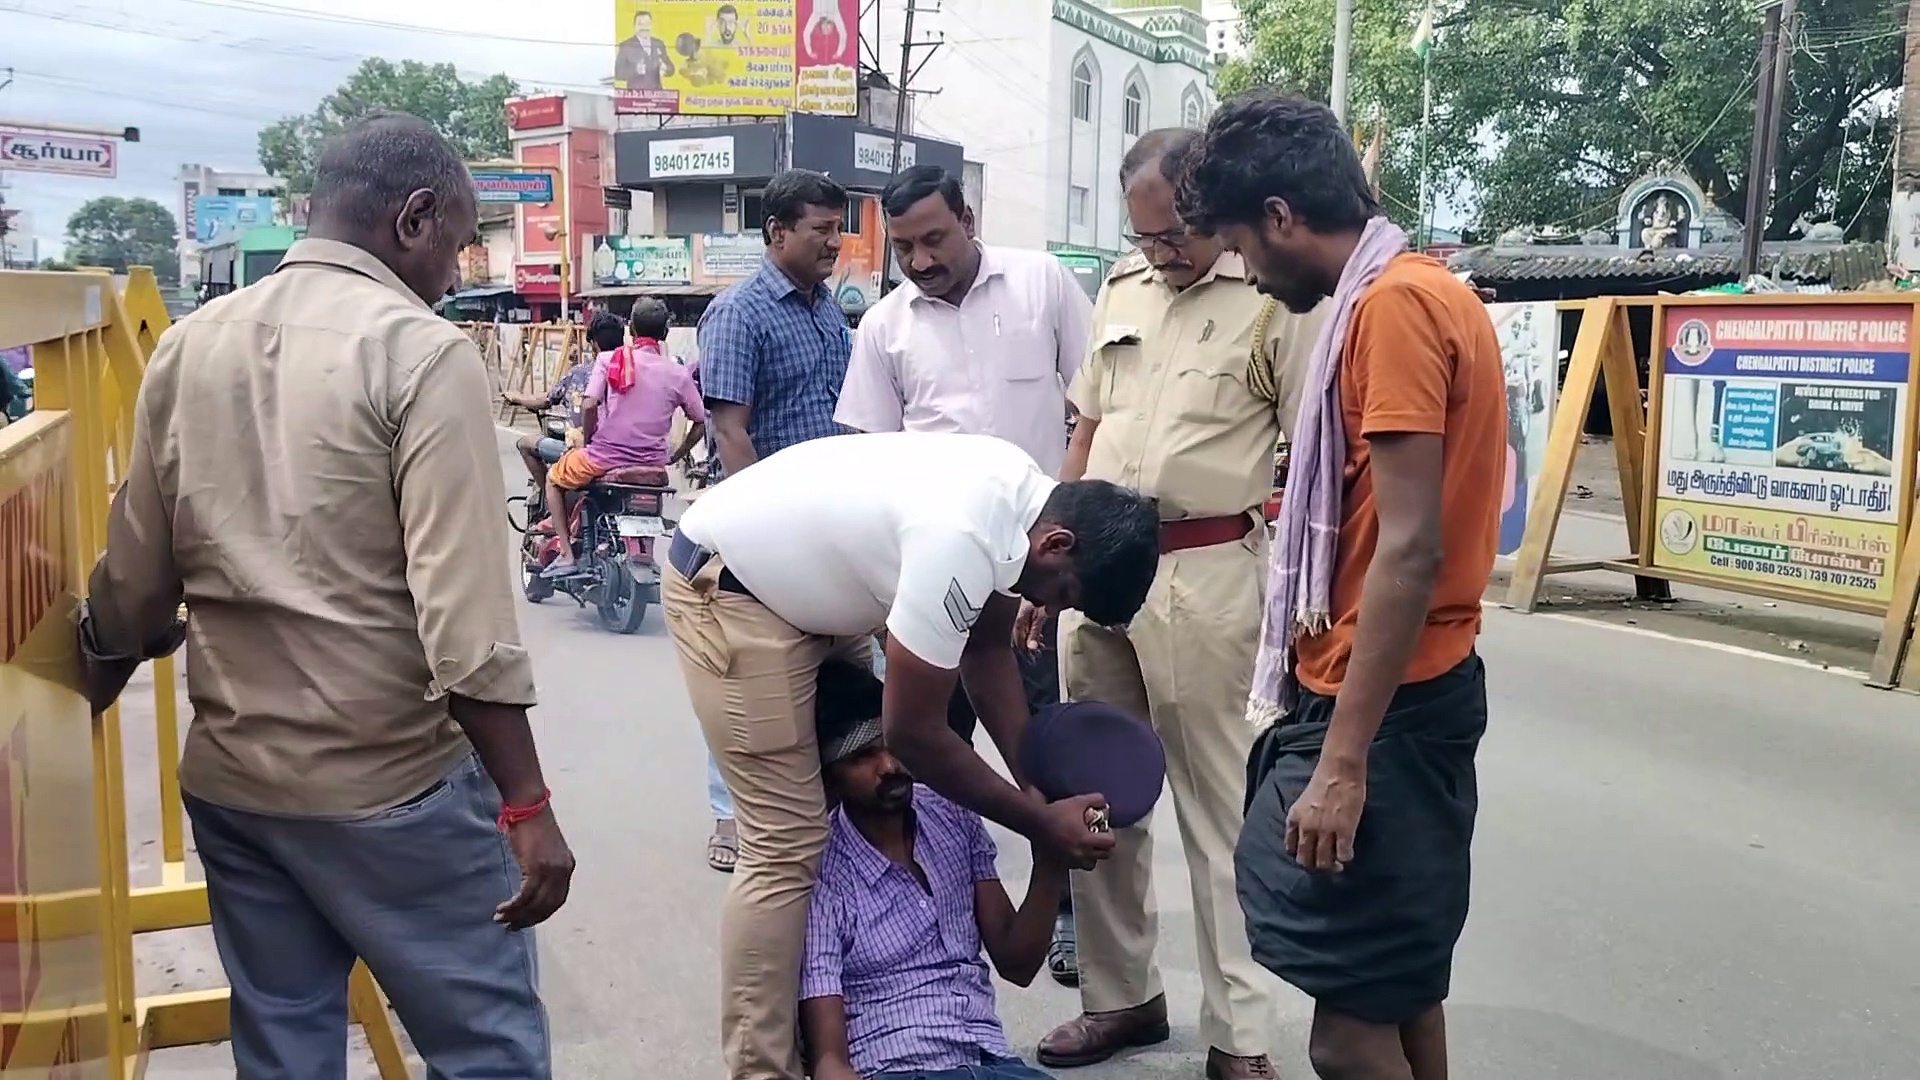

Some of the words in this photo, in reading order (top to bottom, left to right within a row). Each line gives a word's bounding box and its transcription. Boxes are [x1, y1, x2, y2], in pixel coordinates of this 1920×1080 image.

[10, 141, 103, 162] சூர்யா
[1715, 319, 1804, 341] CHENGALPATTU
[1806, 320, 1858, 342] TRAFFIC
[1860, 321, 1906, 343] POLICE
[1736, 355, 1799, 371] CHENGALPATTU
[1800, 356, 1841, 373] DISTRICT
[1842, 357, 1875, 375] POLICE
[1667, 470, 1688, 494] மது
[1691, 469, 1767, 499] அருந்திவிட்டு
[1771, 478, 1827, 502] வாகனம்
[1702, 514, 1780, 539] மாஸ்டர்
[1787, 517, 1891, 554] பிரிண்டர்ஸ்
[1735, 558, 1754, 571] 900
[1756, 561, 1775, 573] 360
[1777, 564, 1802, 578] 2525
[1810, 570, 1827, 582] 739
[1830, 572, 1847, 585] 707
[1849, 575, 1877, 589] 2525
